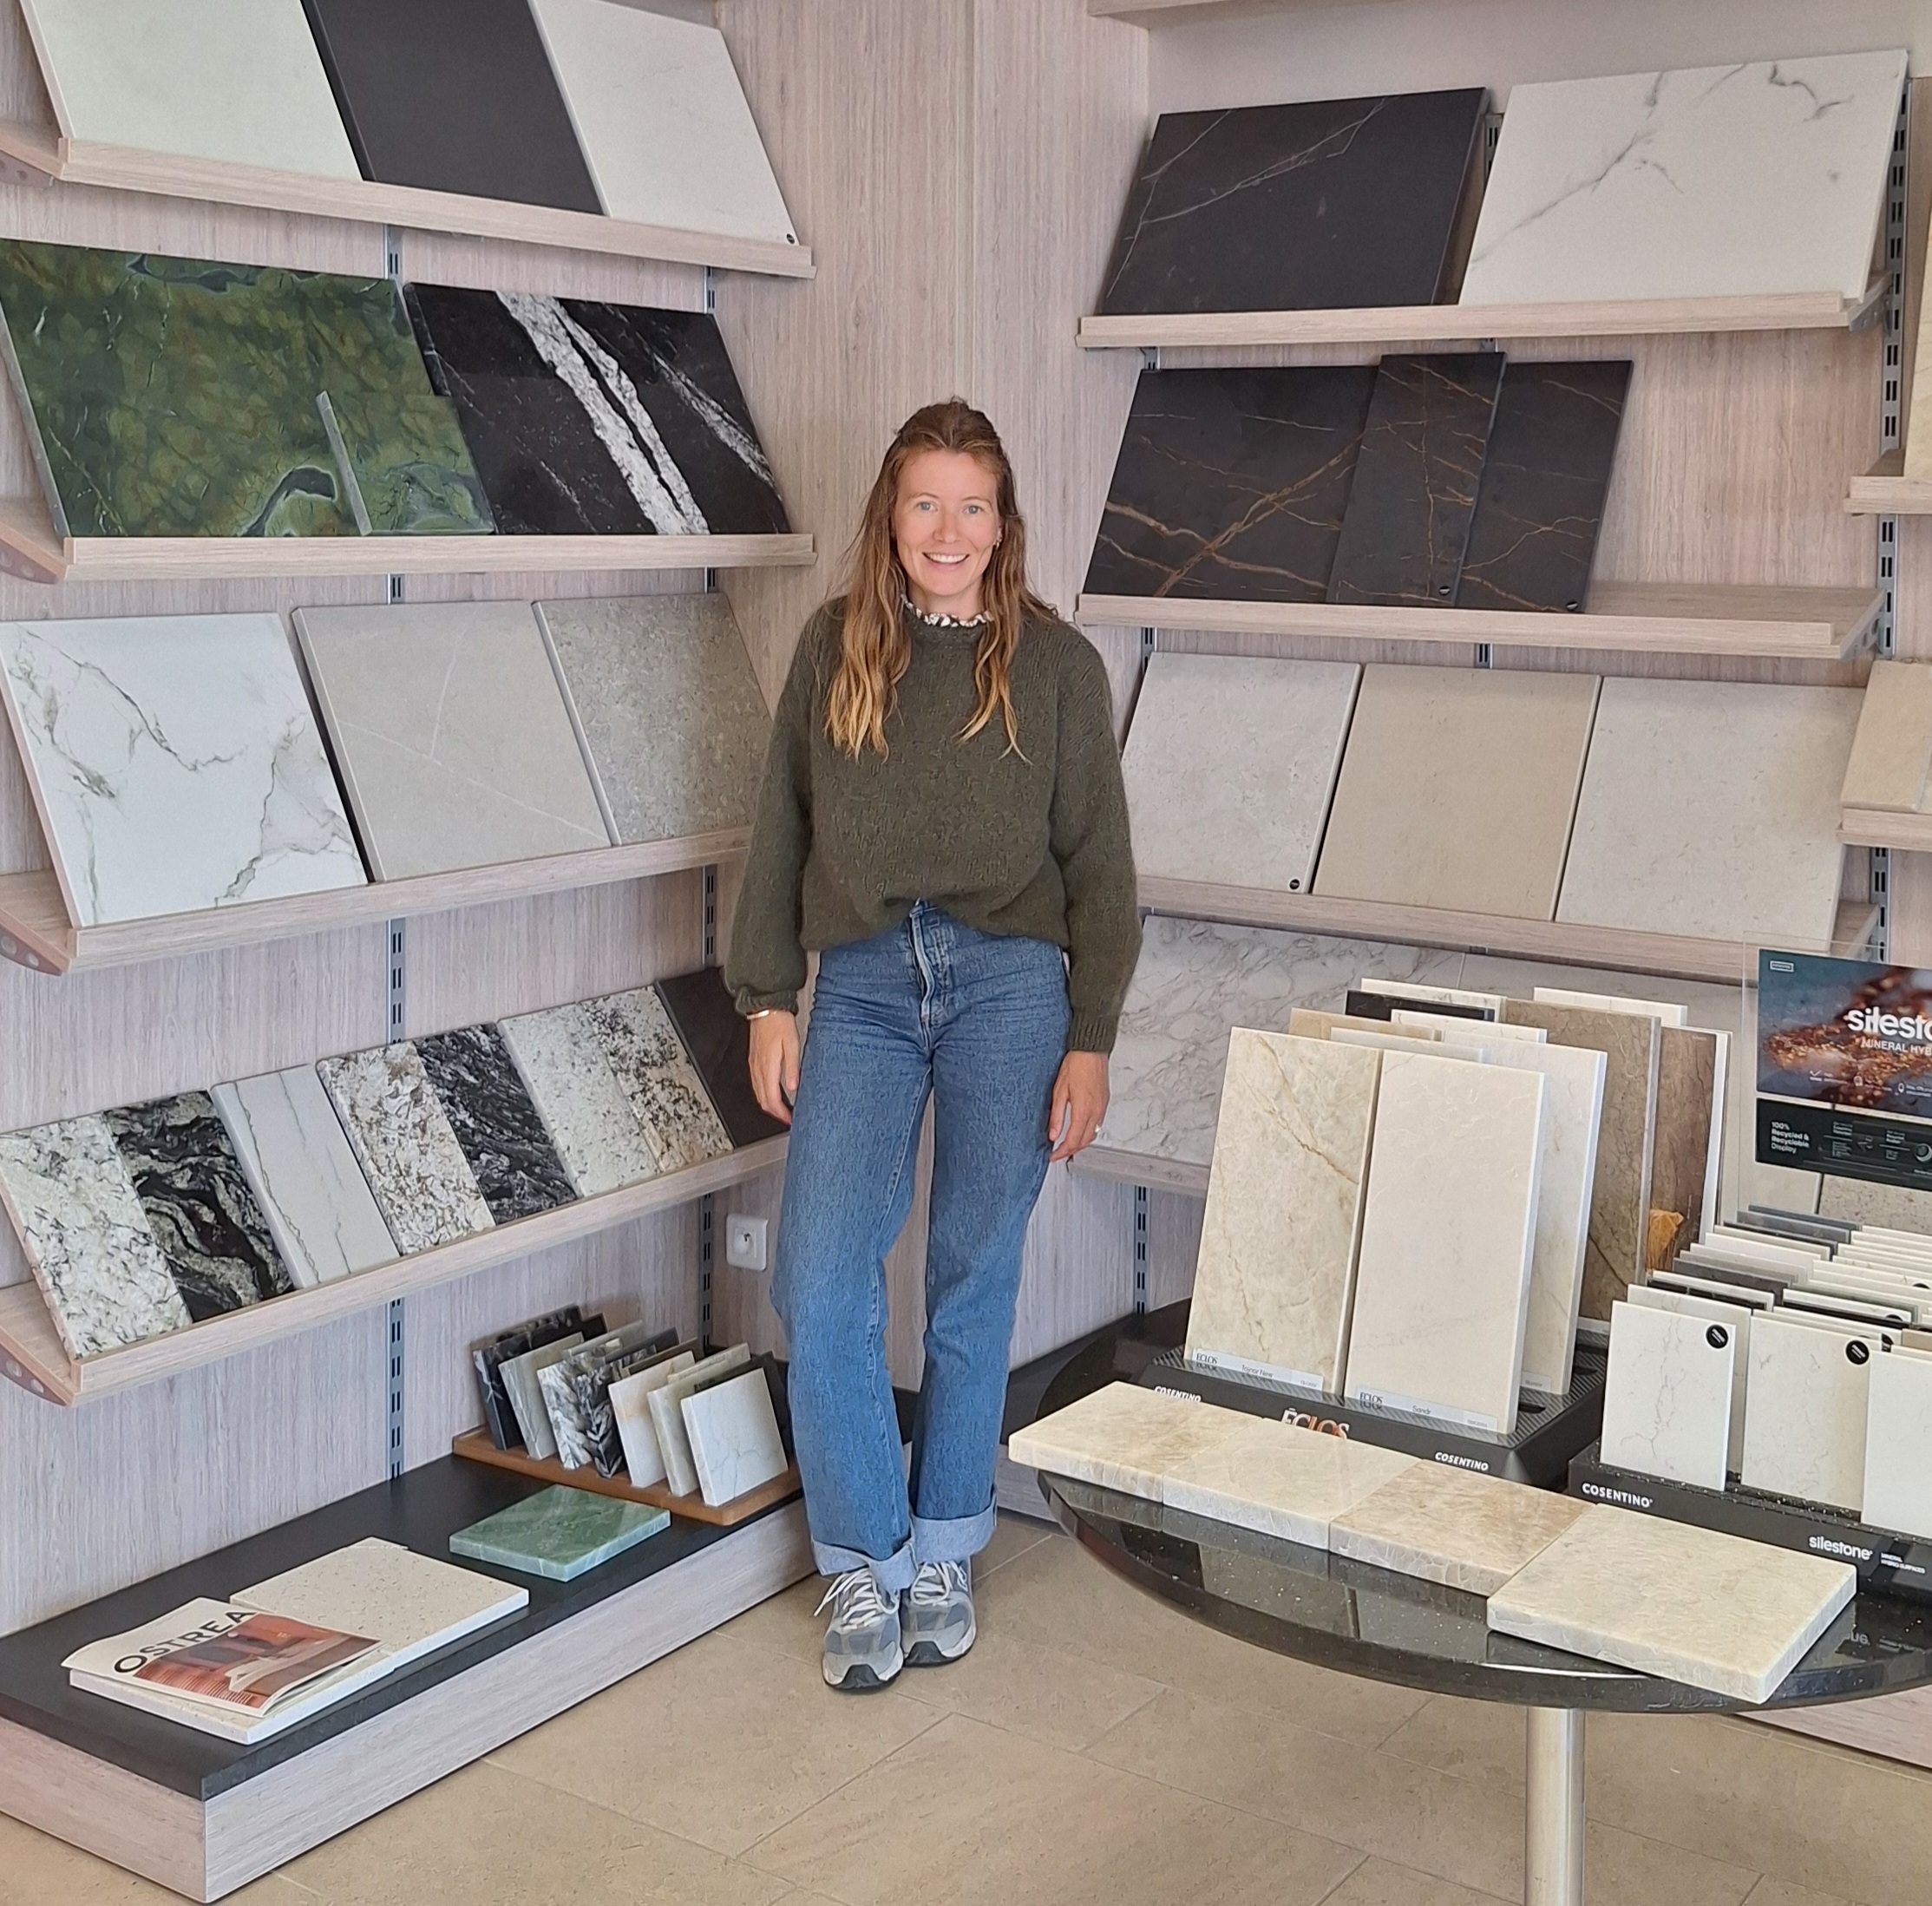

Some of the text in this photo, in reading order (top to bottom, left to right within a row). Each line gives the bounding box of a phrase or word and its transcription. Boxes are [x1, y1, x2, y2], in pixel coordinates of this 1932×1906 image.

[1861, 1037, 1909, 1052] MINERAL
[1771, 1121, 1790, 1130] 100%
[1771, 1129, 1802, 1140] Recycled
[1771, 1136, 1810, 1149] Recyclable
[1771, 1143, 1797, 1154] Display
[1434, 1451, 1490, 1471] COSENTINO
[114, 1611, 259, 1673] OSTREA
